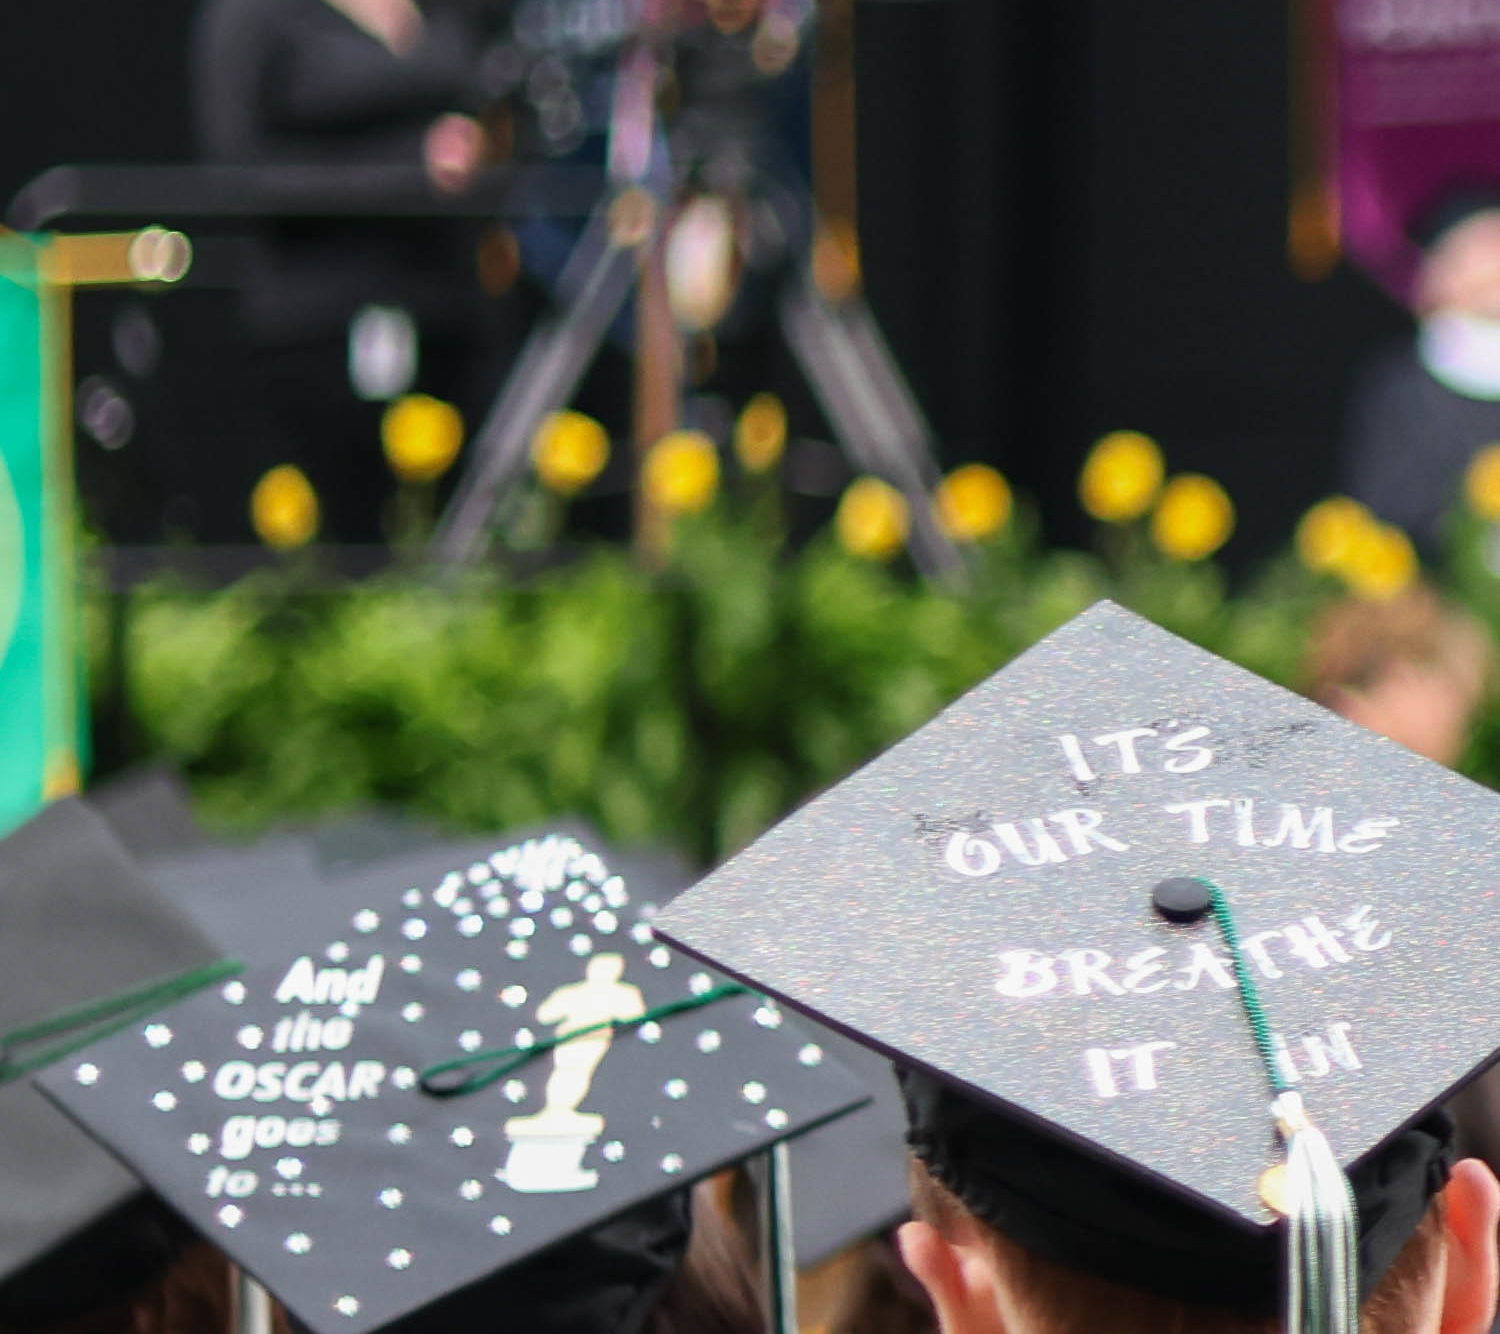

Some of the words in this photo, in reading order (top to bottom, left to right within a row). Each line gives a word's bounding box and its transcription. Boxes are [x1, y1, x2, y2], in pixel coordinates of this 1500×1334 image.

[946, 808, 1130, 877] OUR
[1164, 797, 1400, 854] TIME
[994, 904, 1393, 998] BREATHE
[274, 954, 384, 1004] And
[271, 1009, 353, 1053] the
[213, 1060, 386, 1102] OSCAR
[1084, 1041, 1177, 1098] IT
[1270, 1022, 1364, 1084] IN
[219, 1115, 341, 1160] goes
